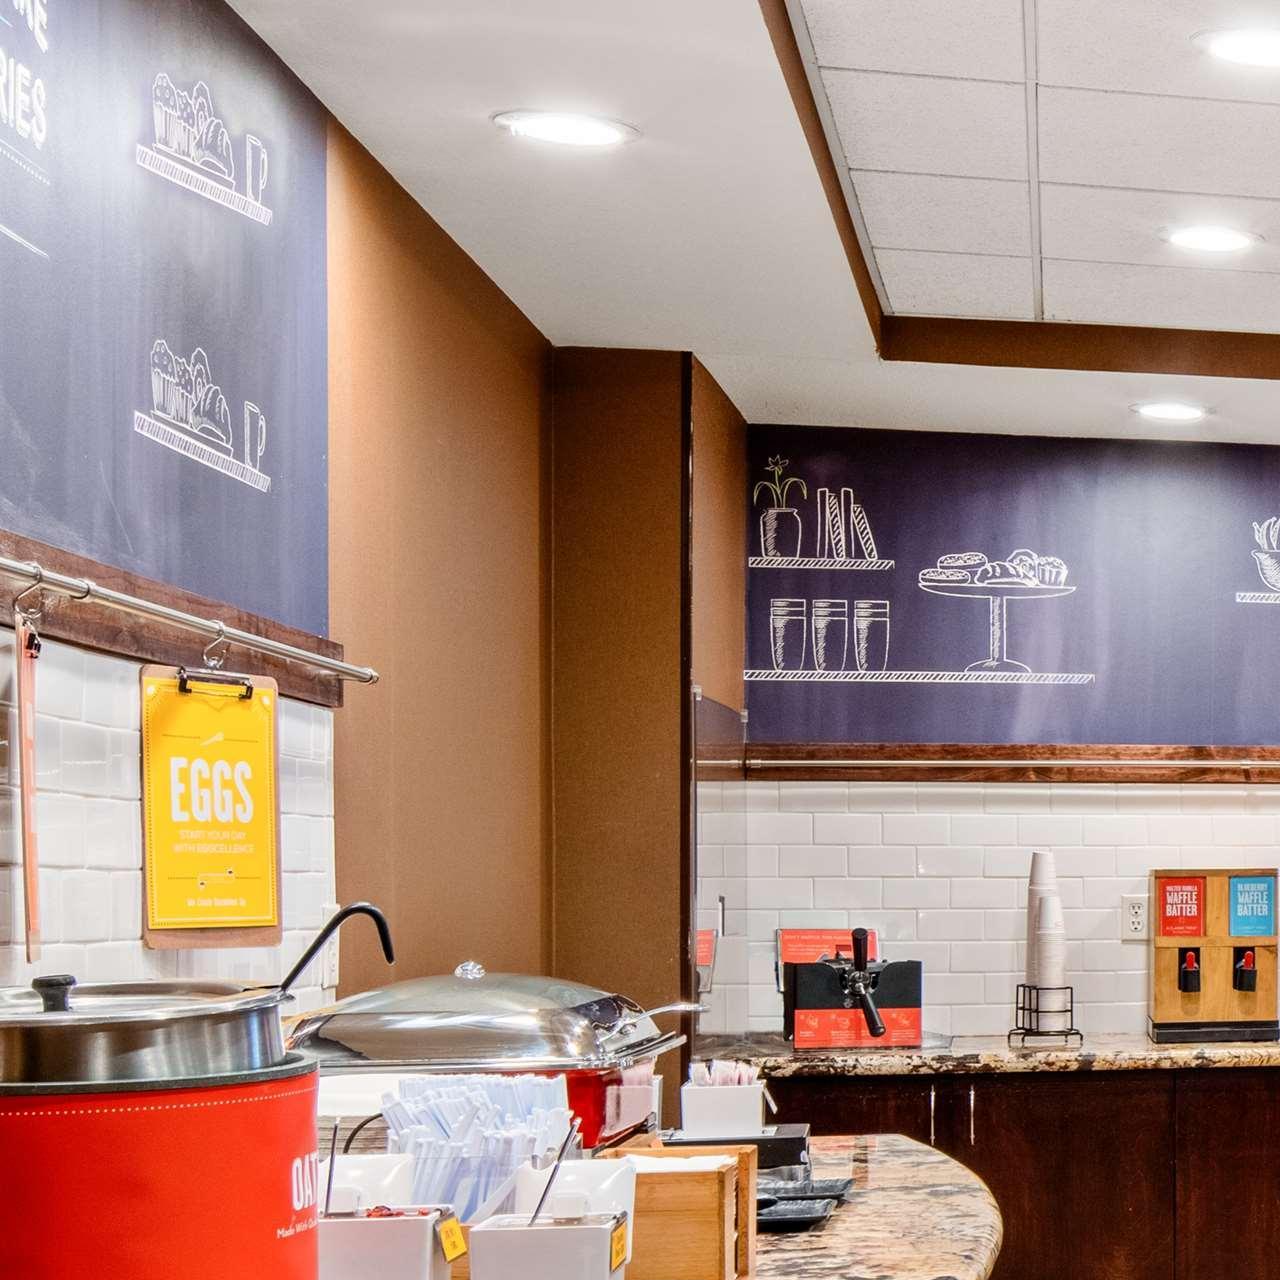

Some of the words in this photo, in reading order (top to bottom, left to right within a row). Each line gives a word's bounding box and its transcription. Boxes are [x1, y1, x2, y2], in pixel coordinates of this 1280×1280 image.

[170, 756, 254, 823] EGGS
[1237, 883, 1268, 892] BLUEBERRY
[1166, 891, 1198, 904] WAFFLE
[1237, 891, 1269, 904] WAFFLE
[1165, 904, 1198, 917] BATTER
[1237, 904, 1269, 917] BATTER
[292, 1151, 318, 1211] OAT
[277, 1223, 295, 1239] Made
